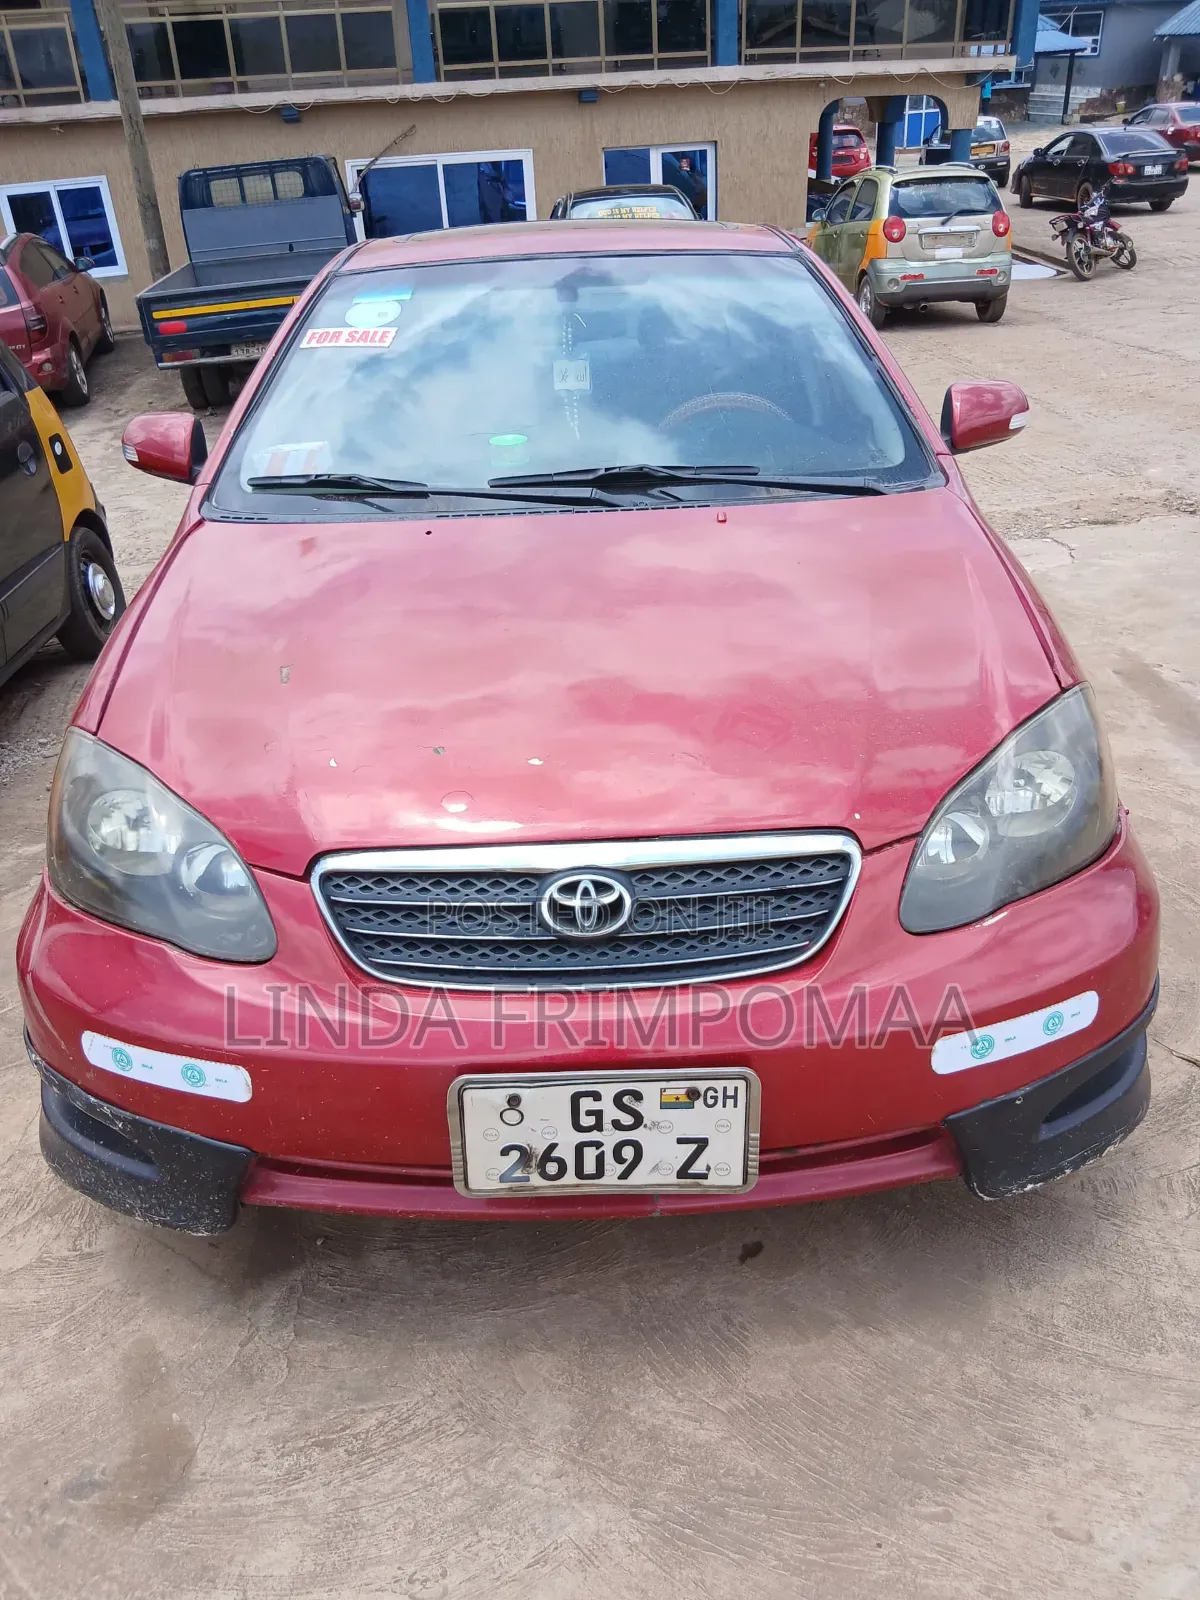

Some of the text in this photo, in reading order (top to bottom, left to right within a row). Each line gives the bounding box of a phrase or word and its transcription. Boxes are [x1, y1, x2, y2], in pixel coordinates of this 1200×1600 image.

[306, 330, 392, 345] FOR SALE
[570, 1088, 645, 1133] GS
[702, 1086, 739, 1109] GH
[499, 1137, 709, 1183] 2609 Z
